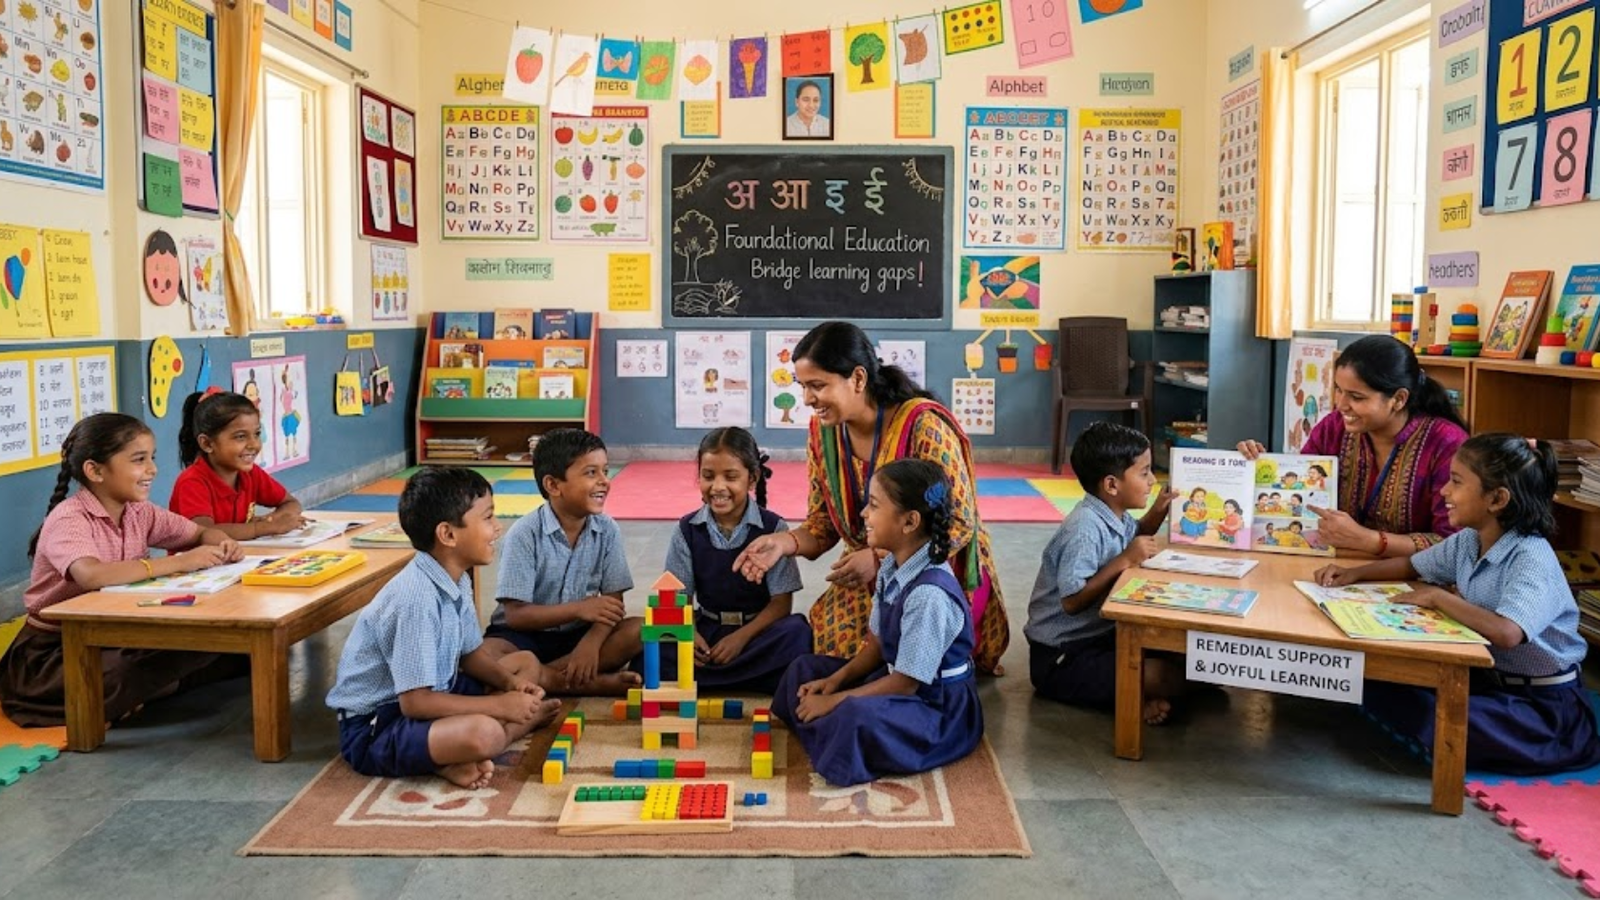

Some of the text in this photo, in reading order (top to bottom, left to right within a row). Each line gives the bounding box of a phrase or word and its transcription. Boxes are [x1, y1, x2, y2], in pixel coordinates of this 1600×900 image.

[1510, 25, 1581, 98] 1 2
[990, 79, 1044, 96] Alphbet
[460, 109, 520, 122] ABCDE
[493, 127, 510, 139] Cc
[995, 129, 1014, 140] Bb
[1019, 130, 1037, 140] Cc
[1108, 130, 1127, 141] Bb
[494, 146, 511, 160] Fg
[970, 146, 988, 157] Ee
[1020, 146, 1037, 160] Fg
[1108, 147, 1127, 160] Gg
[1507, 126, 1578, 190] 7 8
[995, 164, 1011, 177] Jj
[1018, 164, 1036, 174] Kk
[470, 183, 488, 194] Nn
[517, 183, 535, 196] Pp
[725, 166, 888, 215] अ आ इ ई
[1017, 180, 1036, 192] Oo
[1043, 180, 1061, 193] Pp
[494, 201, 511, 213] Ss
[1018, 197, 1036, 208] Ss
[468, 220, 491, 231] Ww
[1018, 214, 1035, 225] Xx
[1042, 214, 1059, 228] Yy
[1132, 214, 1150, 226] Xx
[726, 224, 930, 254] Foundational Education
[751, 258, 924, 294] Bridge learning gaps!
[39, 399, 50, 411] 10
[1196, 638, 1352, 669] REMEDIAL SUPPORT
[1195, 660, 1351, 692] & JOYFUL LEARNING
